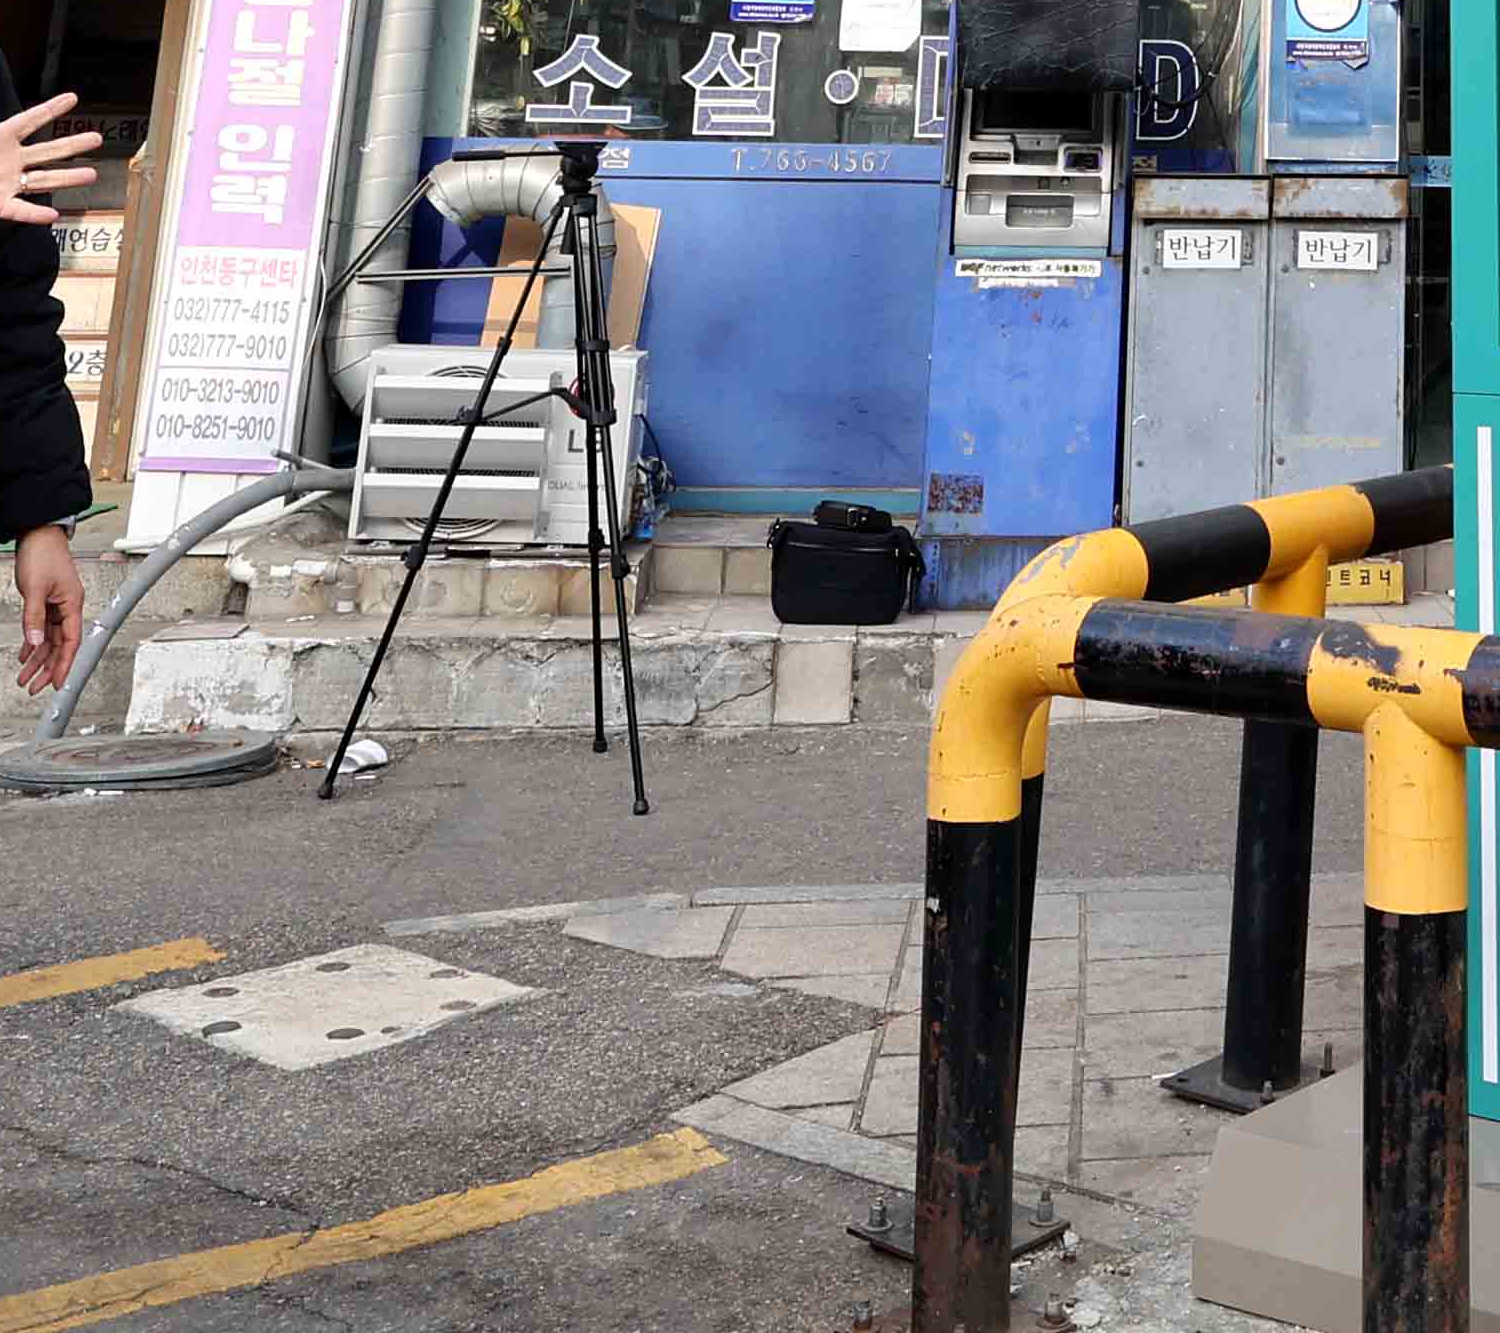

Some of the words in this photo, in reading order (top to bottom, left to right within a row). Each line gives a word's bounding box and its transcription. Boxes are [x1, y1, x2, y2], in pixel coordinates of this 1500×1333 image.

[524, 31, 781, 137] 소설
[210, 122, 294, 226] 인력
[1169, 236, 1238, 262] 반납기
[1304, 237, 1373, 264] 반납기
[173, 296, 291, 325] 032)777-4115
[167, 333, 287, 361] 032)777-9010
[161, 377, 280, 405] 010-3213-9010
[155, 413, 276, 441] 010-8251-9010
